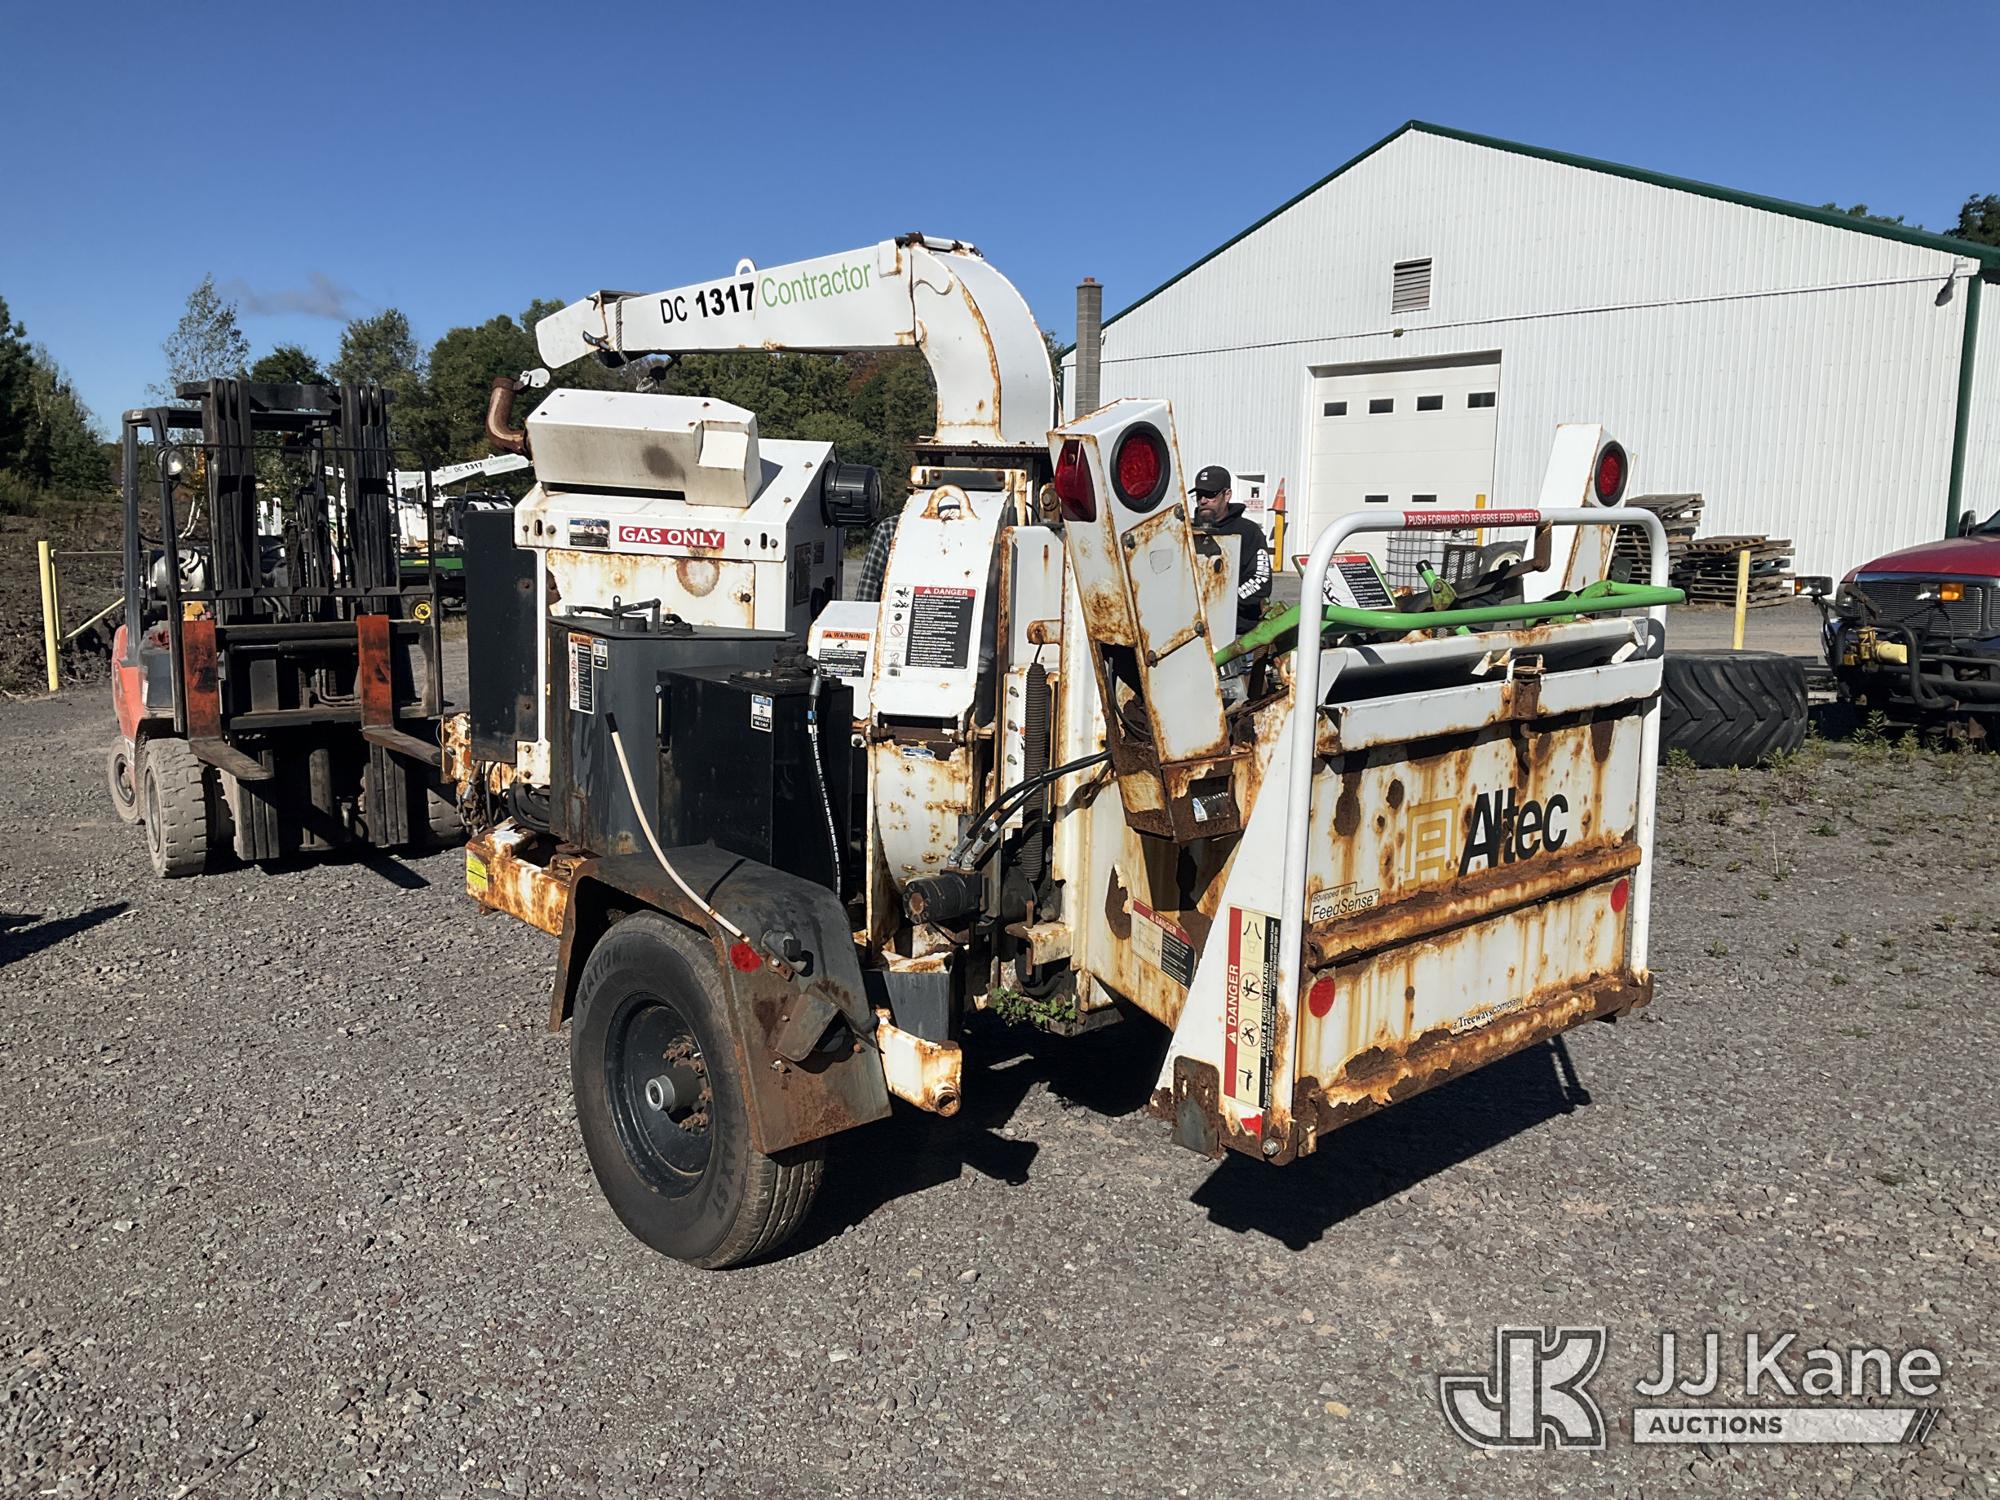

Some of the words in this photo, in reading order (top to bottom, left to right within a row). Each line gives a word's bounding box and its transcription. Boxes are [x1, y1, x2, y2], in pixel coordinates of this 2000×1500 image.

[660, 296, 688, 324] DC
[695, 281, 755, 318] 1317
[761, 263, 871, 308] Contractor
[1407, 515, 1428, 525] PUSH
[1427, 514, 1460, 525] FORWARD
[1470, 513, 1499, 524] REVERSE
[1499, 512, 1515, 523] FEED
[1515, 511, 1540, 522] WHEELS
[621, 527, 662, 544] GAS
[666, 530, 721, 547] ONLY
[933, 588, 968, 596] DANGER
[833, 632, 866, 640] WARNING
[1458, 787, 1569, 877] Altec
[1155, 914, 1177, 935] DANGER
[1227, 964, 1239, 1026] DANGER
